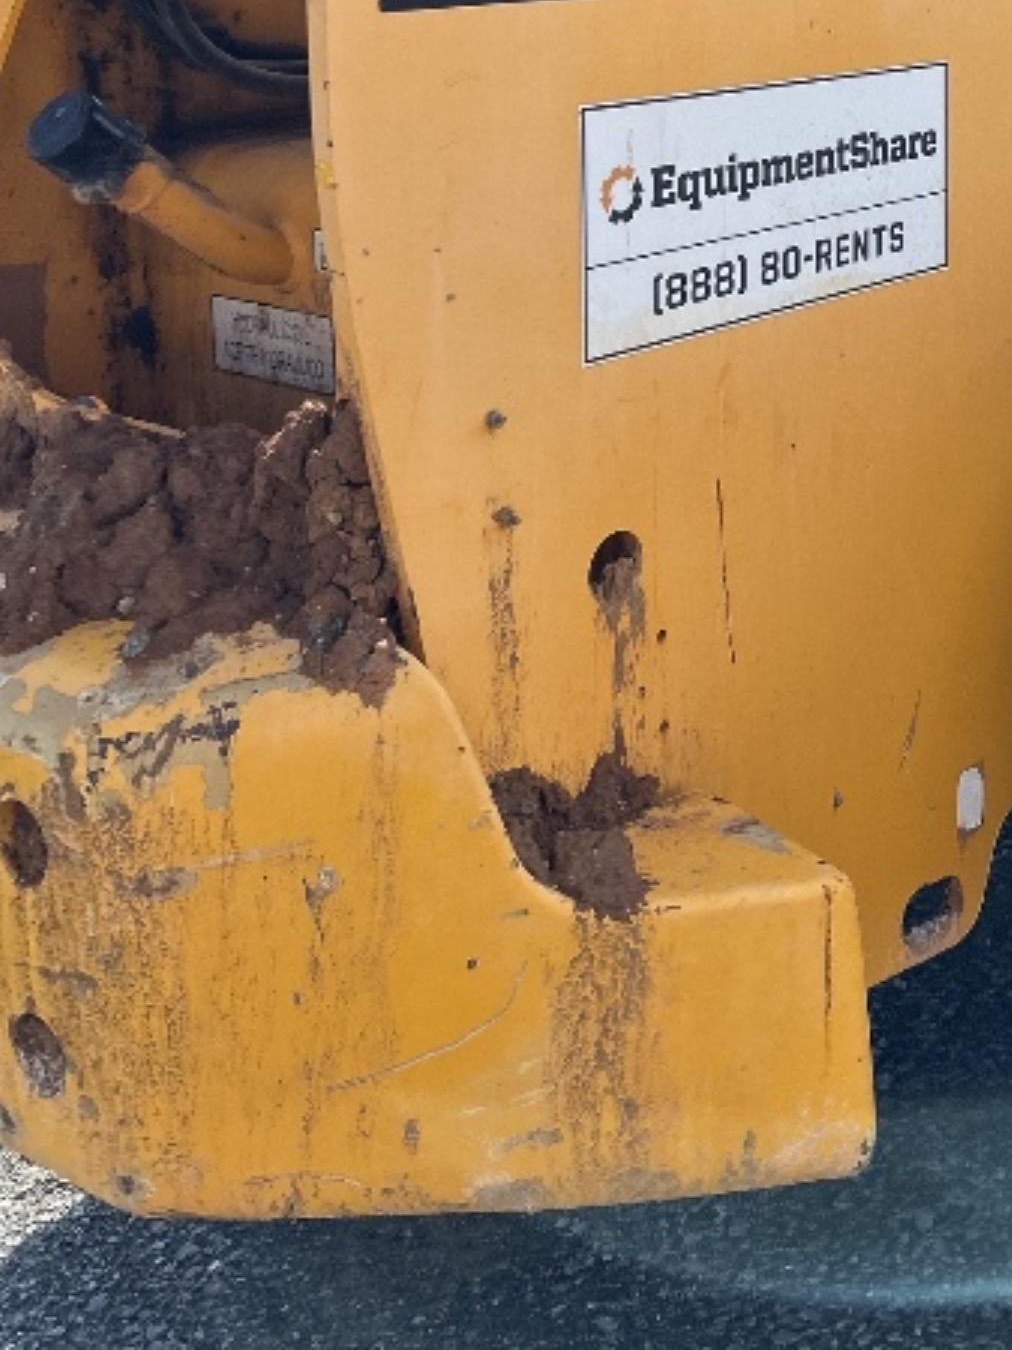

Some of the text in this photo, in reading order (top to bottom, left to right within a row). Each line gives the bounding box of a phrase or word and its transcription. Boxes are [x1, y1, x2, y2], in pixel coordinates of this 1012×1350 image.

[650, 127, 937, 211] EquipmentShare
[652, 221, 905, 316] (888) 80-RENTS
